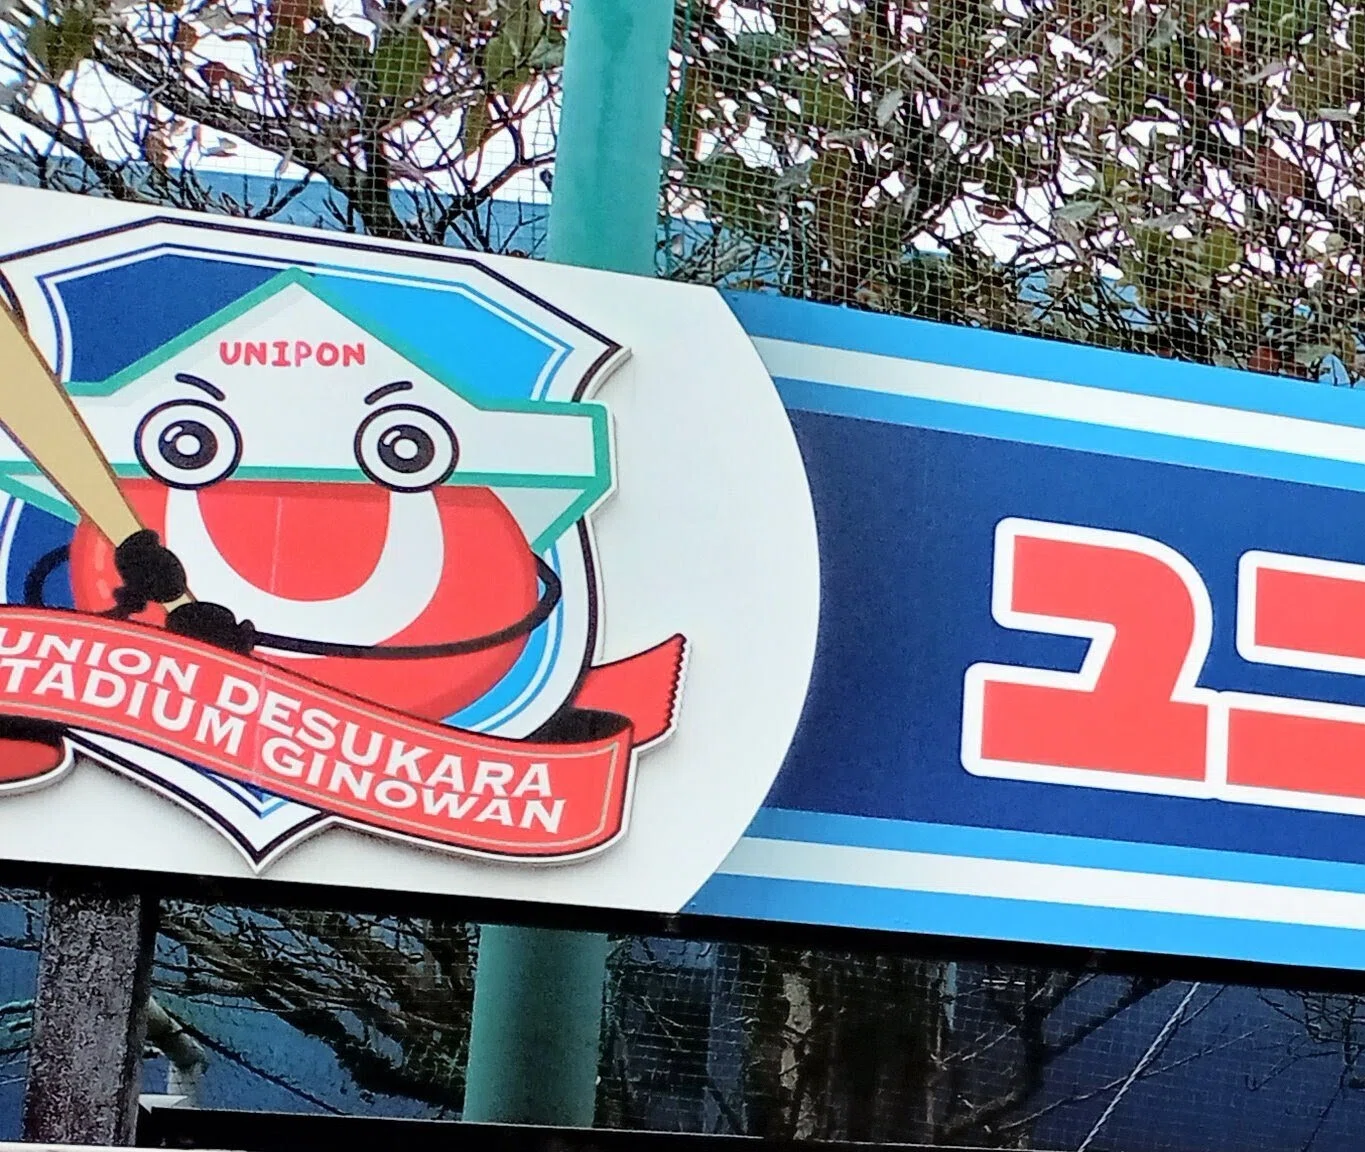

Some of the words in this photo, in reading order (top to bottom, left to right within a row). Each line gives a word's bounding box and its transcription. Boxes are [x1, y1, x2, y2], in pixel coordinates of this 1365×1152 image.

[219, 341, 366, 367] UNIPON
[0, 626, 201, 693] UNION
[215, 673, 554, 799] DESUKARA
[262, 737, 567, 835] GINOWAN
